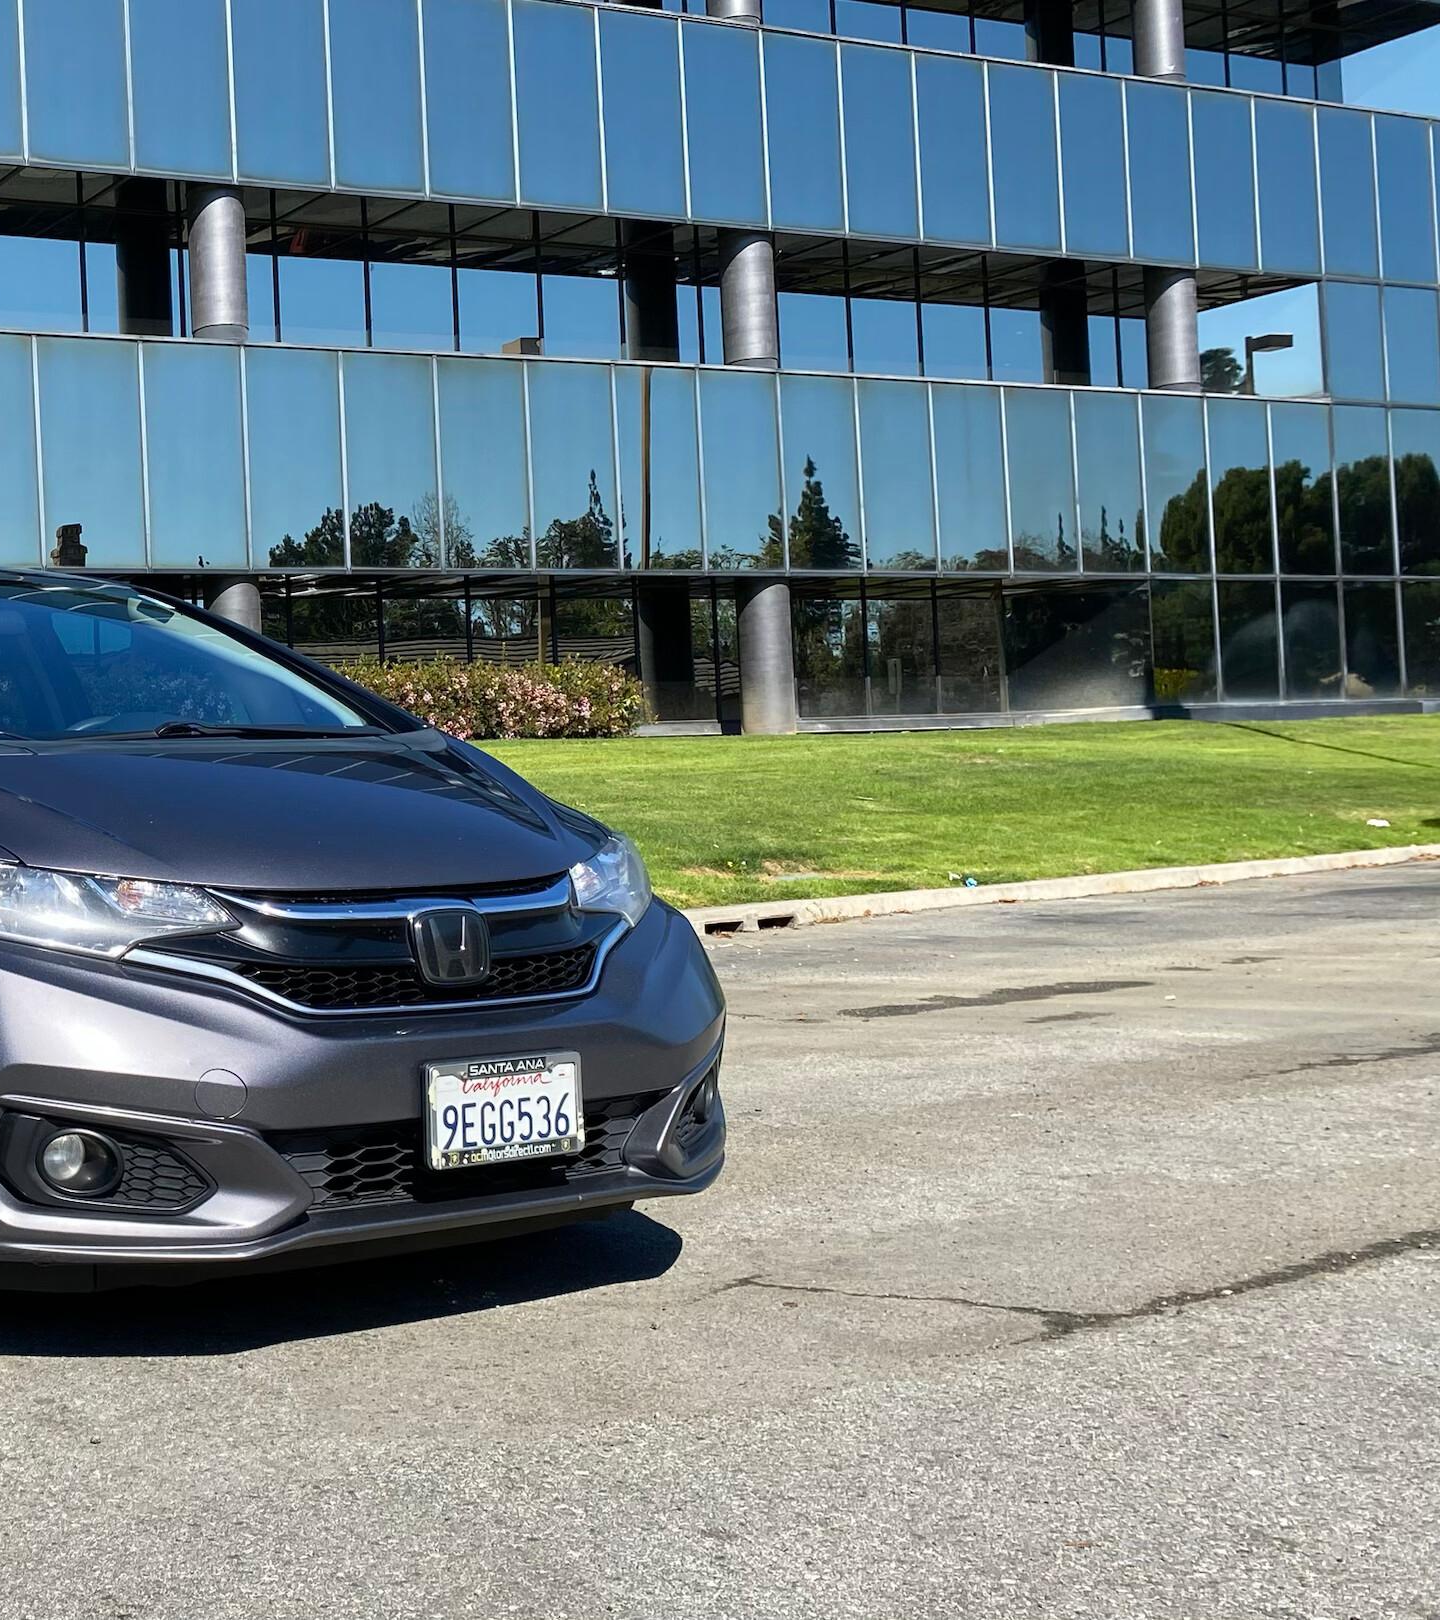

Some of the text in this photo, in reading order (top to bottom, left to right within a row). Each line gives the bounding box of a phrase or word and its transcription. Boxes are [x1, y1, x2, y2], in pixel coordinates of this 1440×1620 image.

[469, 1058, 545, 1076] SANTA ANA
[462, 1072, 552, 1097] California
[442, 1092, 571, 1150] 9EGG536
